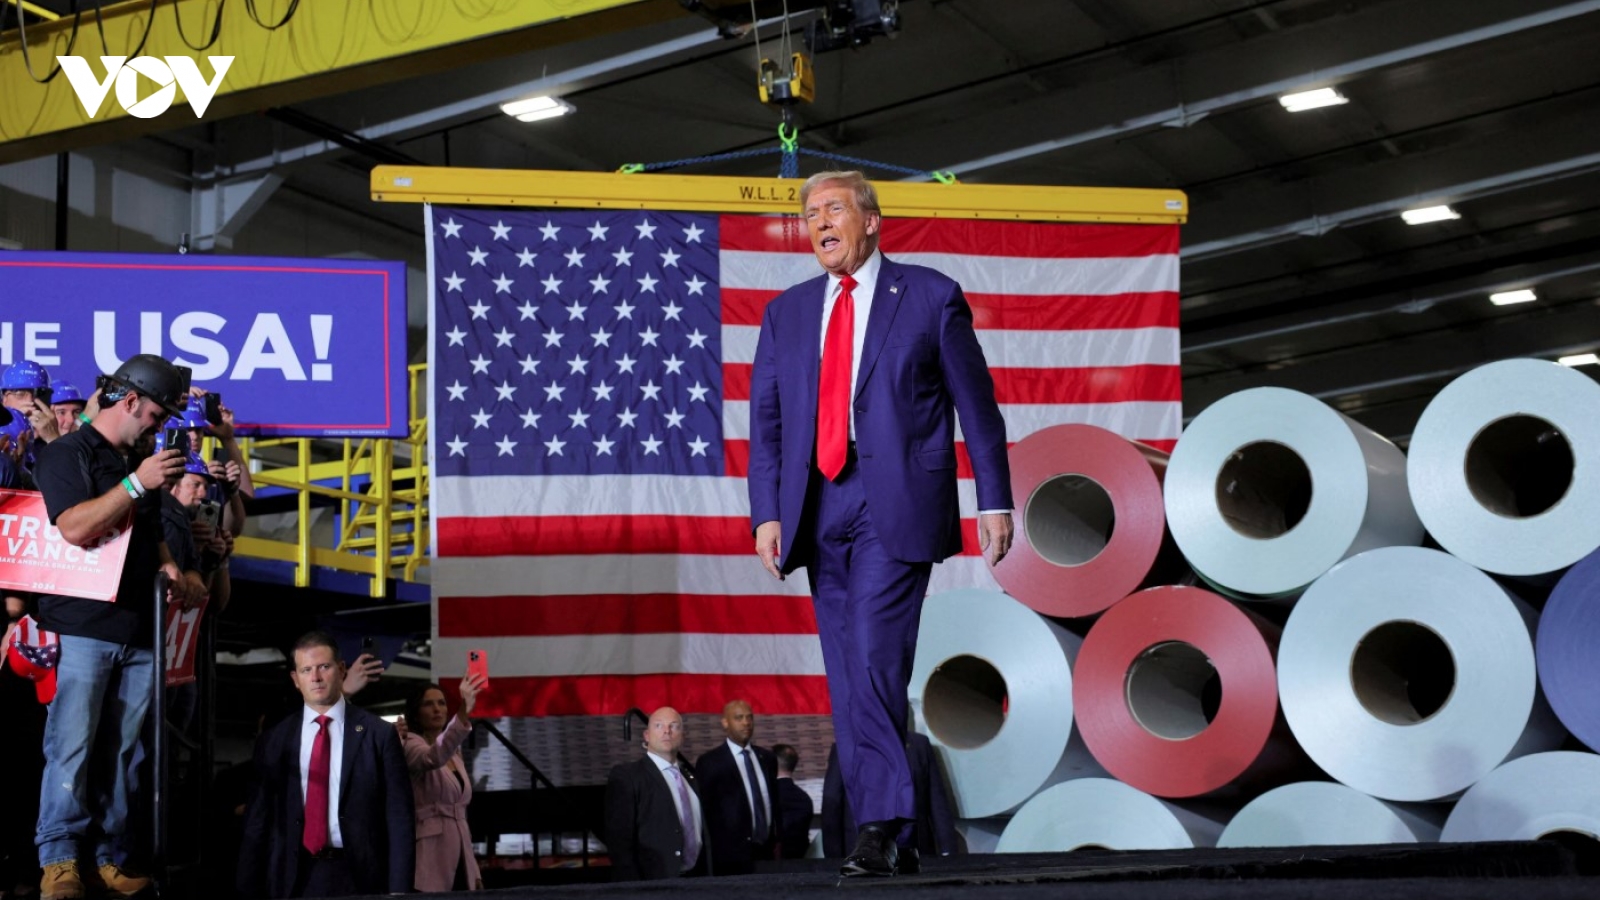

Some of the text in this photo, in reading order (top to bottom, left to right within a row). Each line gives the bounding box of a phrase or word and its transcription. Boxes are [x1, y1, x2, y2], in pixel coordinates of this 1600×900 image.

[739, 186, 783, 200] W.L.L.
[93, 310, 333, 381] USA!
[0, 513, 120, 547] TRUP
[8, 537, 101, 566] VANCE
[18, 558, 49, 567] AMERICA
[52, 562, 75, 570] GREAT
[165, 607, 200, 671] 47
